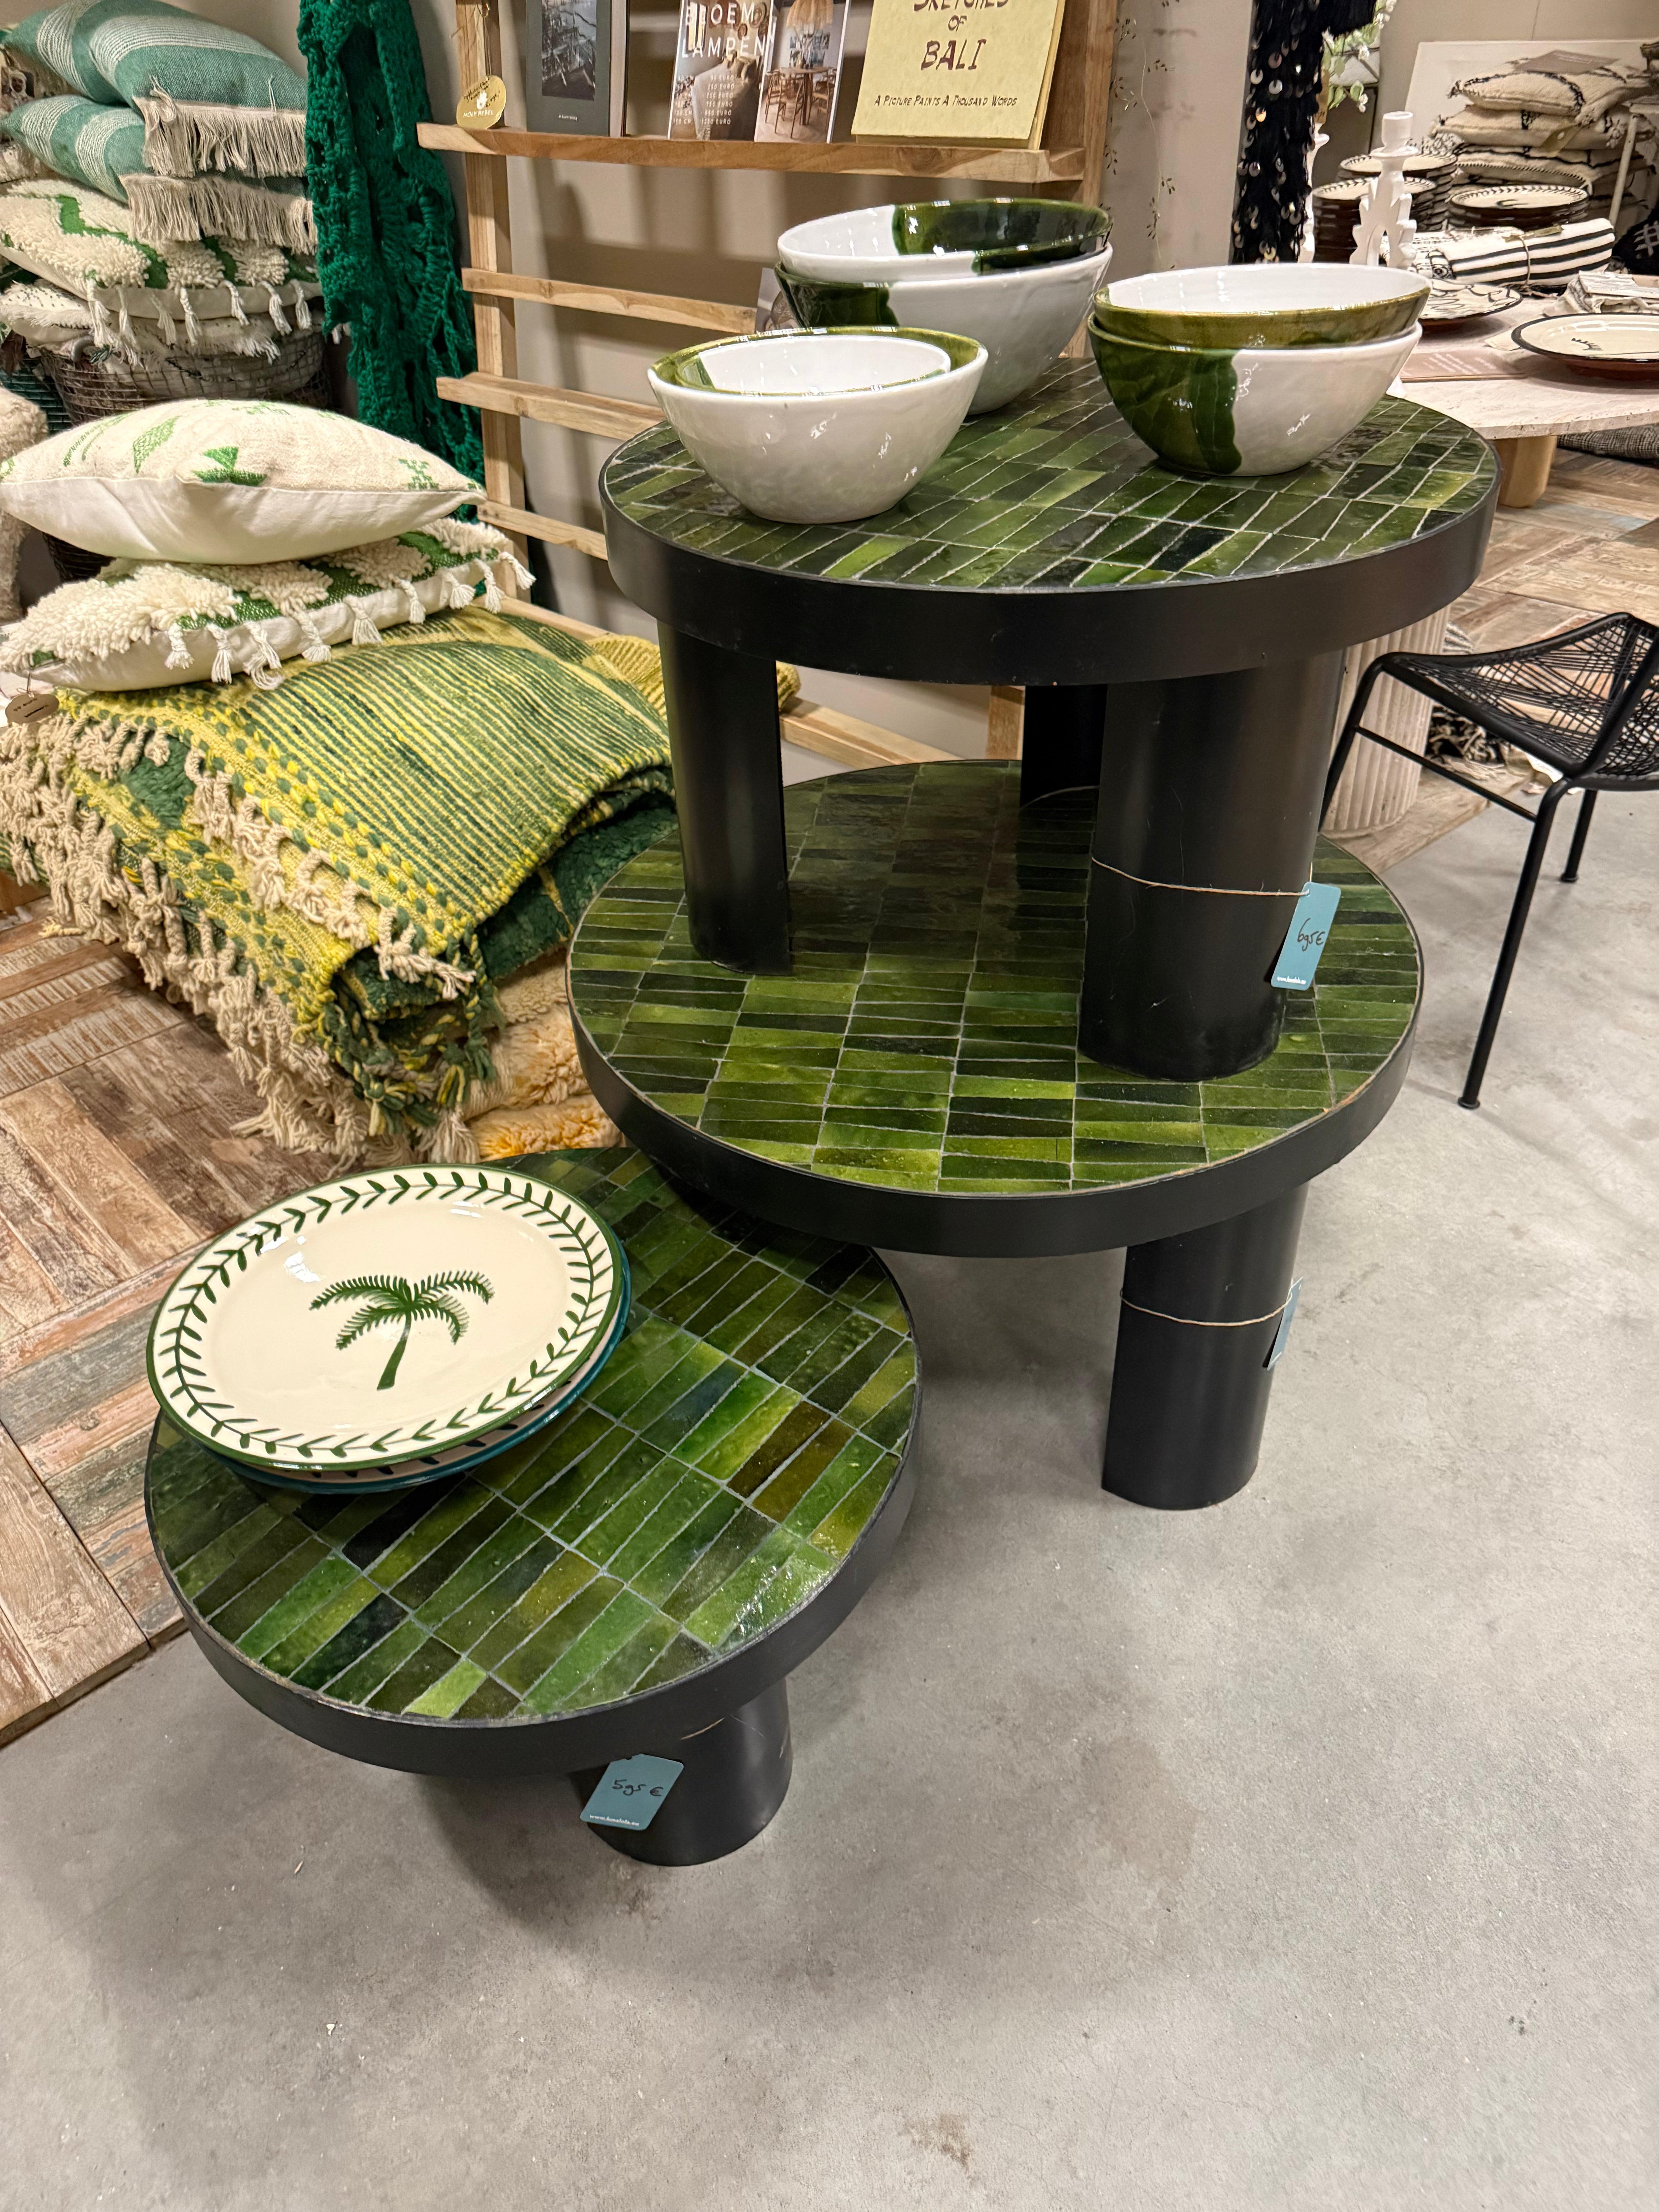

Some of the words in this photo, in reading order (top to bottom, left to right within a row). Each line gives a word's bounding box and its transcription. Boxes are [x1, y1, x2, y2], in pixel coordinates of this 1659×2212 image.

[948, 15, 967, 31] OF
[682, 35, 766, 58] LAMPEN
[921, 39, 987, 70] BALI
[874, 95, 881, 106] A
[942, 95, 949, 106] A
